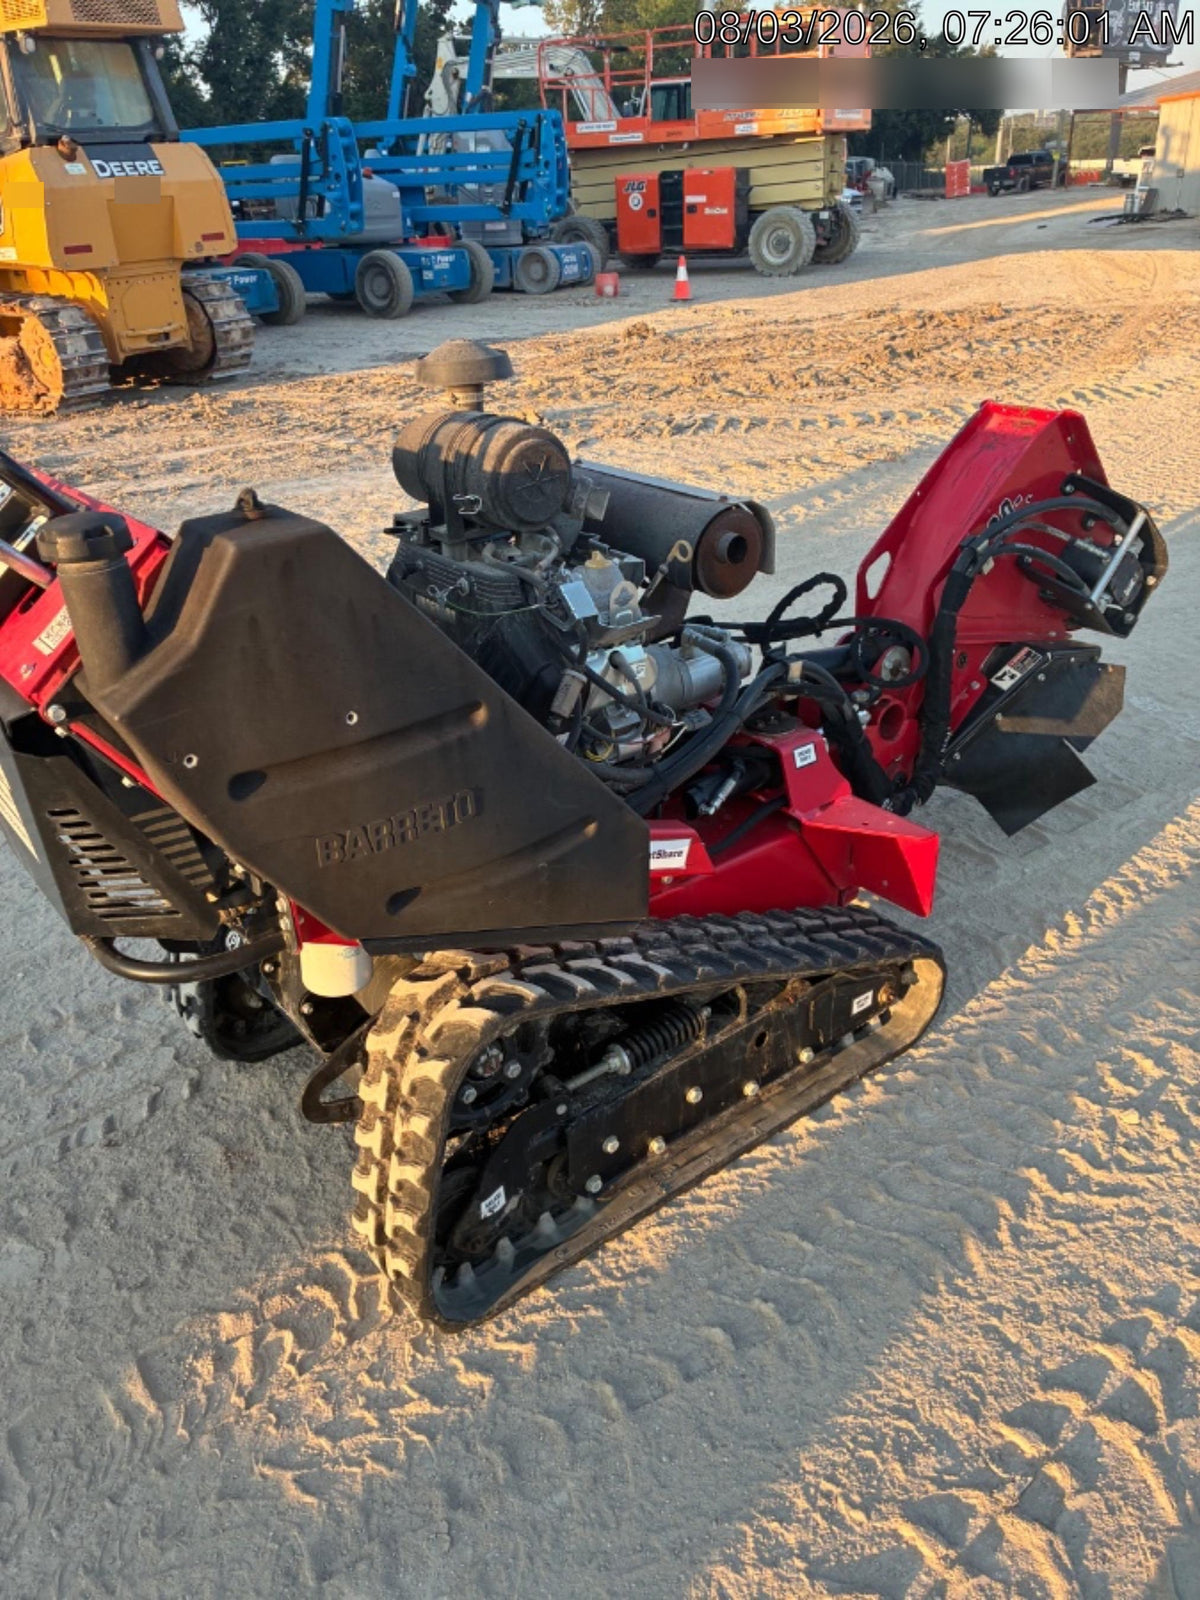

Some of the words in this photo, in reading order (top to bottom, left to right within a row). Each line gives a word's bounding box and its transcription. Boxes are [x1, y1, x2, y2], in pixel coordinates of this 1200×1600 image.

[90, 160, 164, 177] DEERE
[623, 181, 646, 192] JLG
[315, 788, 482, 868] BARRETO
